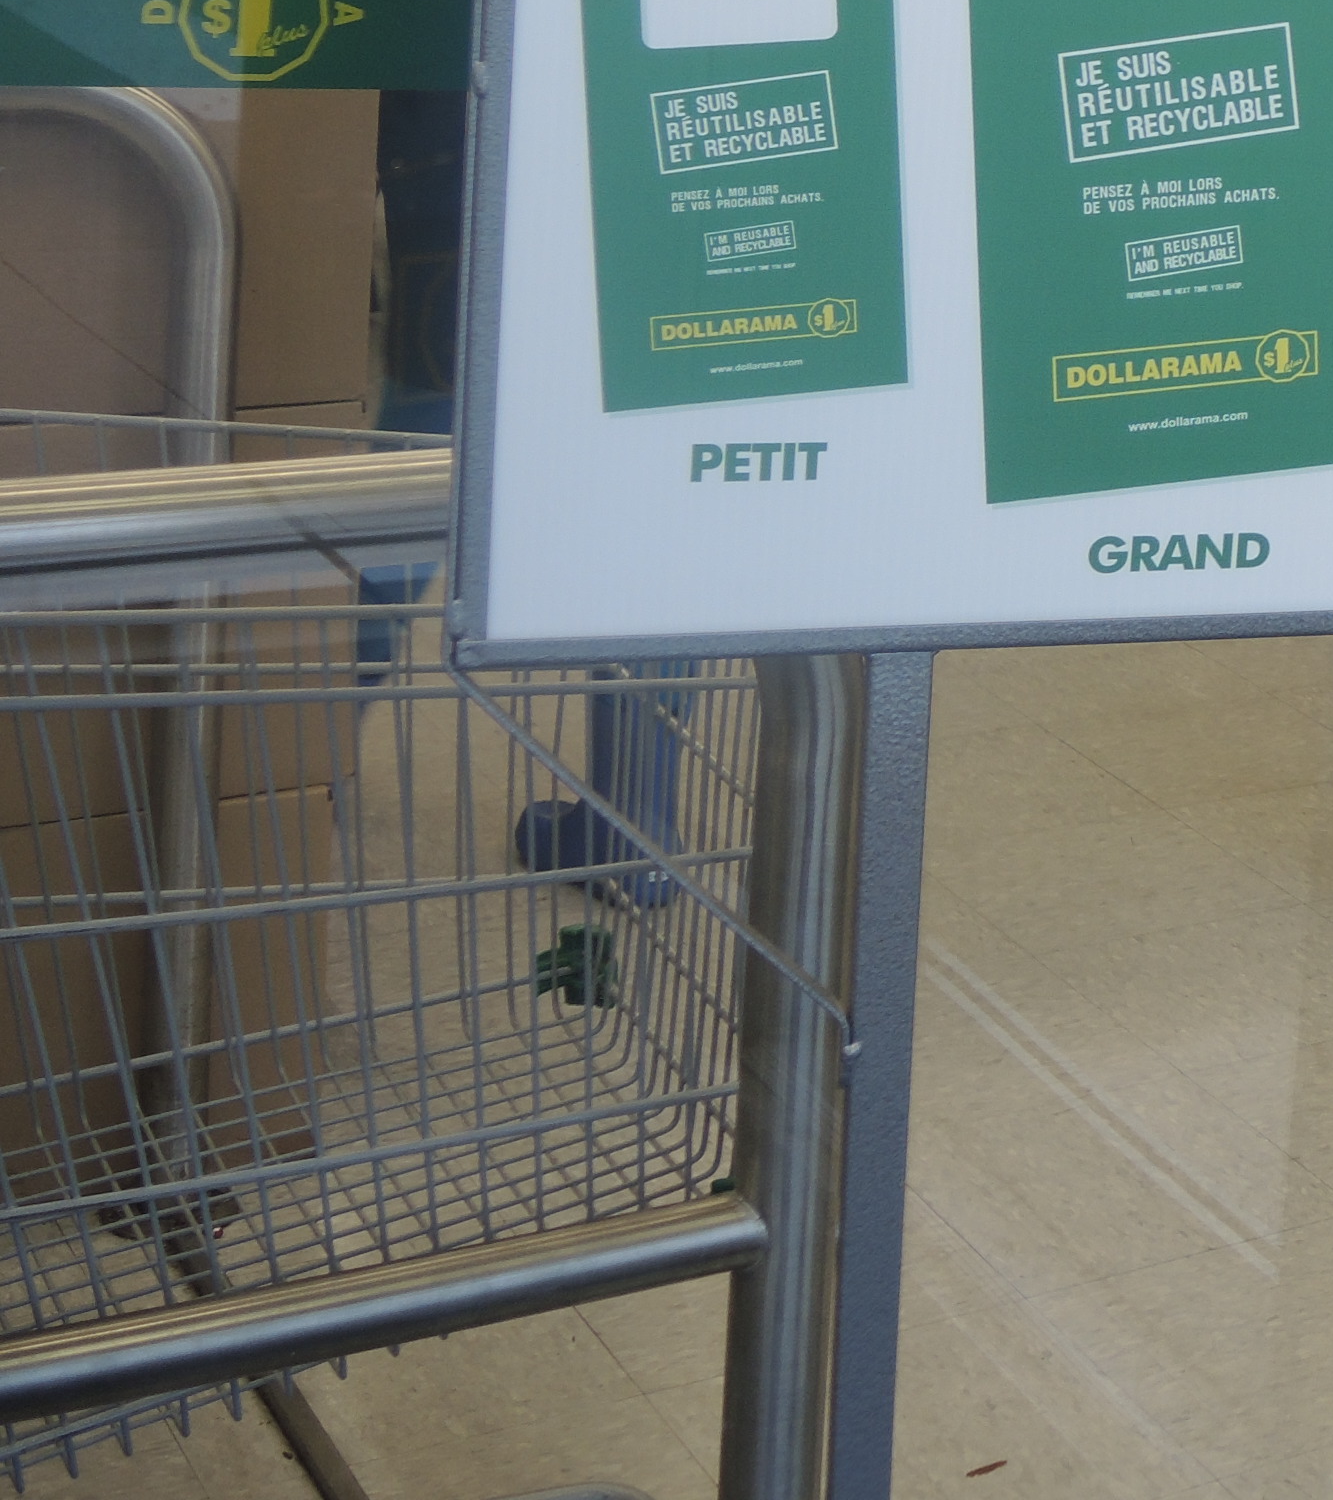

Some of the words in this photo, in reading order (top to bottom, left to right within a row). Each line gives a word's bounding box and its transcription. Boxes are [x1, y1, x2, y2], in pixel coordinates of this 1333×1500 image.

[1076, 60, 1103, 87] JE
[1117, 51, 1171, 78] SUIS
[1078, 64, 1280, 117] RÉUTILISABLE
[664, 98, 685, 118] JE
[696, 92, 738, 113] SUIS
[666, 101, 823, 141] RÉUTILISABLE
[1082, 121, 1111, 148] ET
[1127, 94, 1283, 140] RECYCLABLE
[670, 143, 692, 163] ET
[705, 123, 827, 158] RECYCLABLE
[671, 188, 710, 201] PENSEZ
[753, 185, 780, 195] LORS
[1082, 184, 1132, 200] PENSEZ
[1141, 180, 1151, 196] À
[1157, 181, 1182, 194] MOI
[1189, 177, 1222, 192] LORS
[1083, 200, 1101, 215] DE
[1108, 197, 1135, 212] VOS
[1142, 192, 1216, 209] PROCHAINS
[1224, 187, 1280, 203] ACHATS.
[671, 201, 686, 213] DE
[691, 200, 712, 211] VOS
[717, 196, 775, 209] PROCHAINS
[1163, 232, 1235, 255] REUSABLE
[1134, 259, 1158, 274] AND
[1164, 246, 1236, 269] RECYCLABLE
[661, 313, 798, 341] DOLLARAMA
[1066, 349, 1241, 389] DOLLARAMA
[1128, 408, 1249, 434] www.dollarama.com
[689, 442, 827, 484] PETIT
[1086, 531, 1272, 575] GRAND
